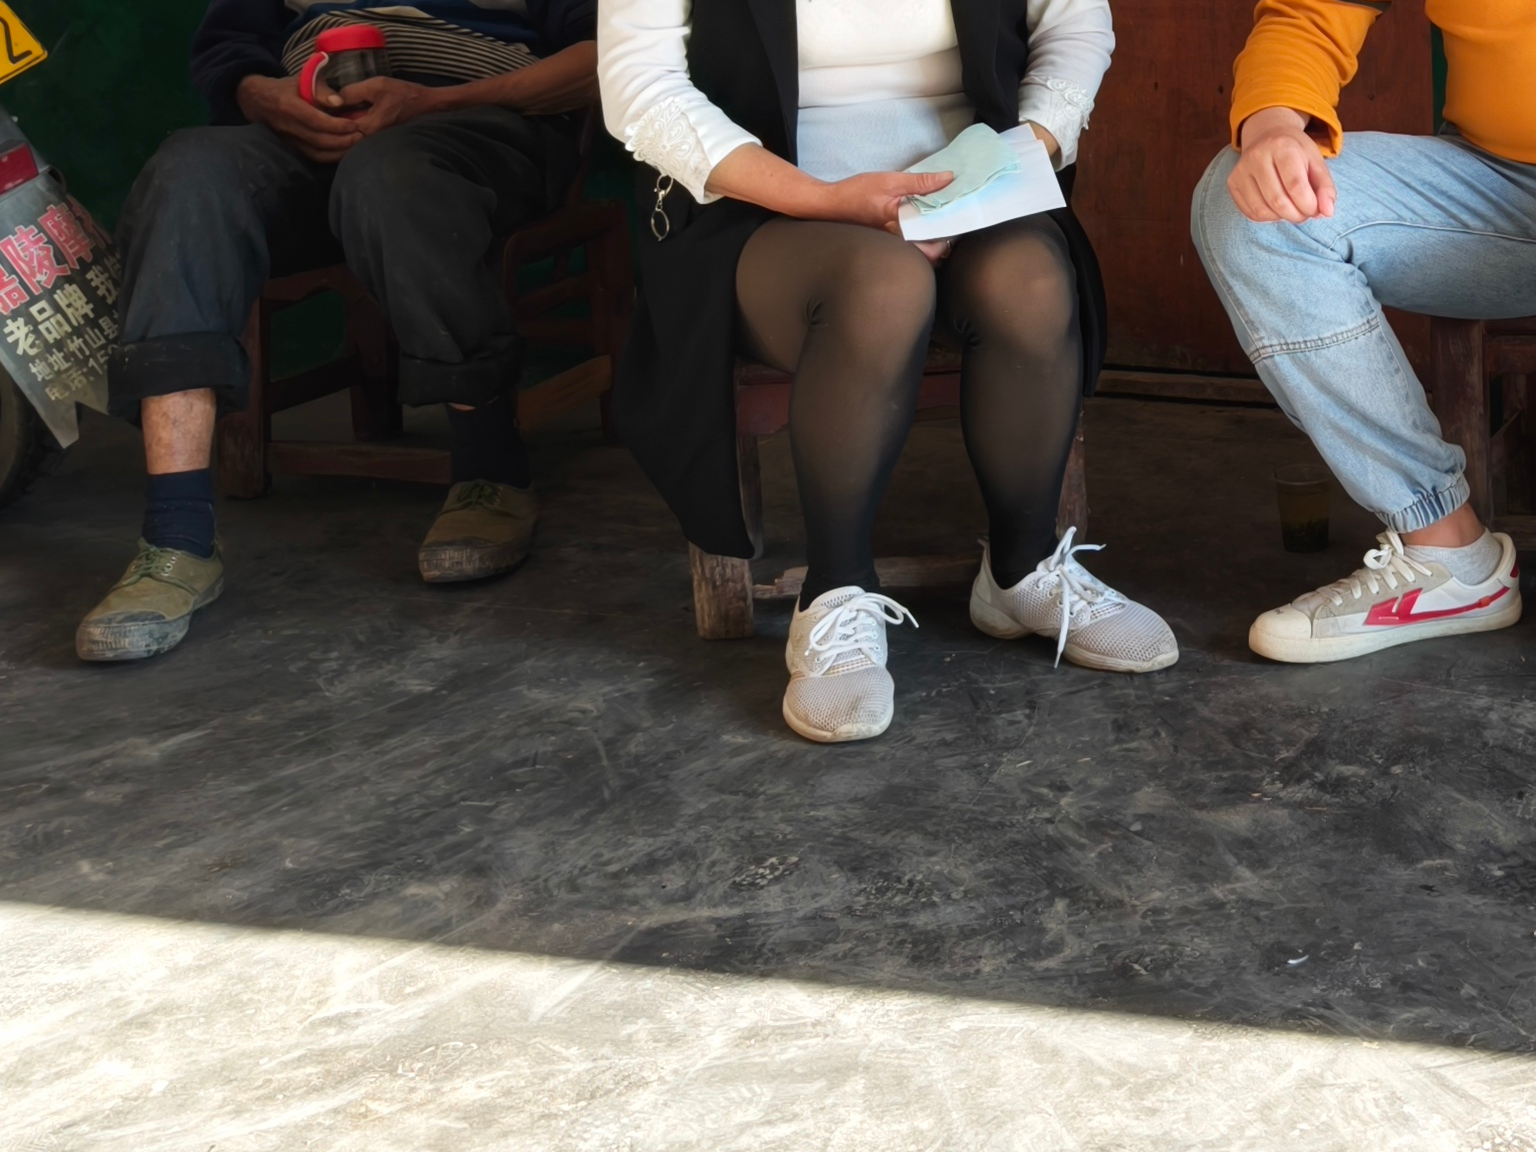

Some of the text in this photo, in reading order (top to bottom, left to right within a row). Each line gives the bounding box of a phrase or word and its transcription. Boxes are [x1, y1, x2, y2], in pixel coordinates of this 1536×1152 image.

[3, 282, 95, 356] 老品牌
[29, 309, 119, 382] 地址:竹山县
